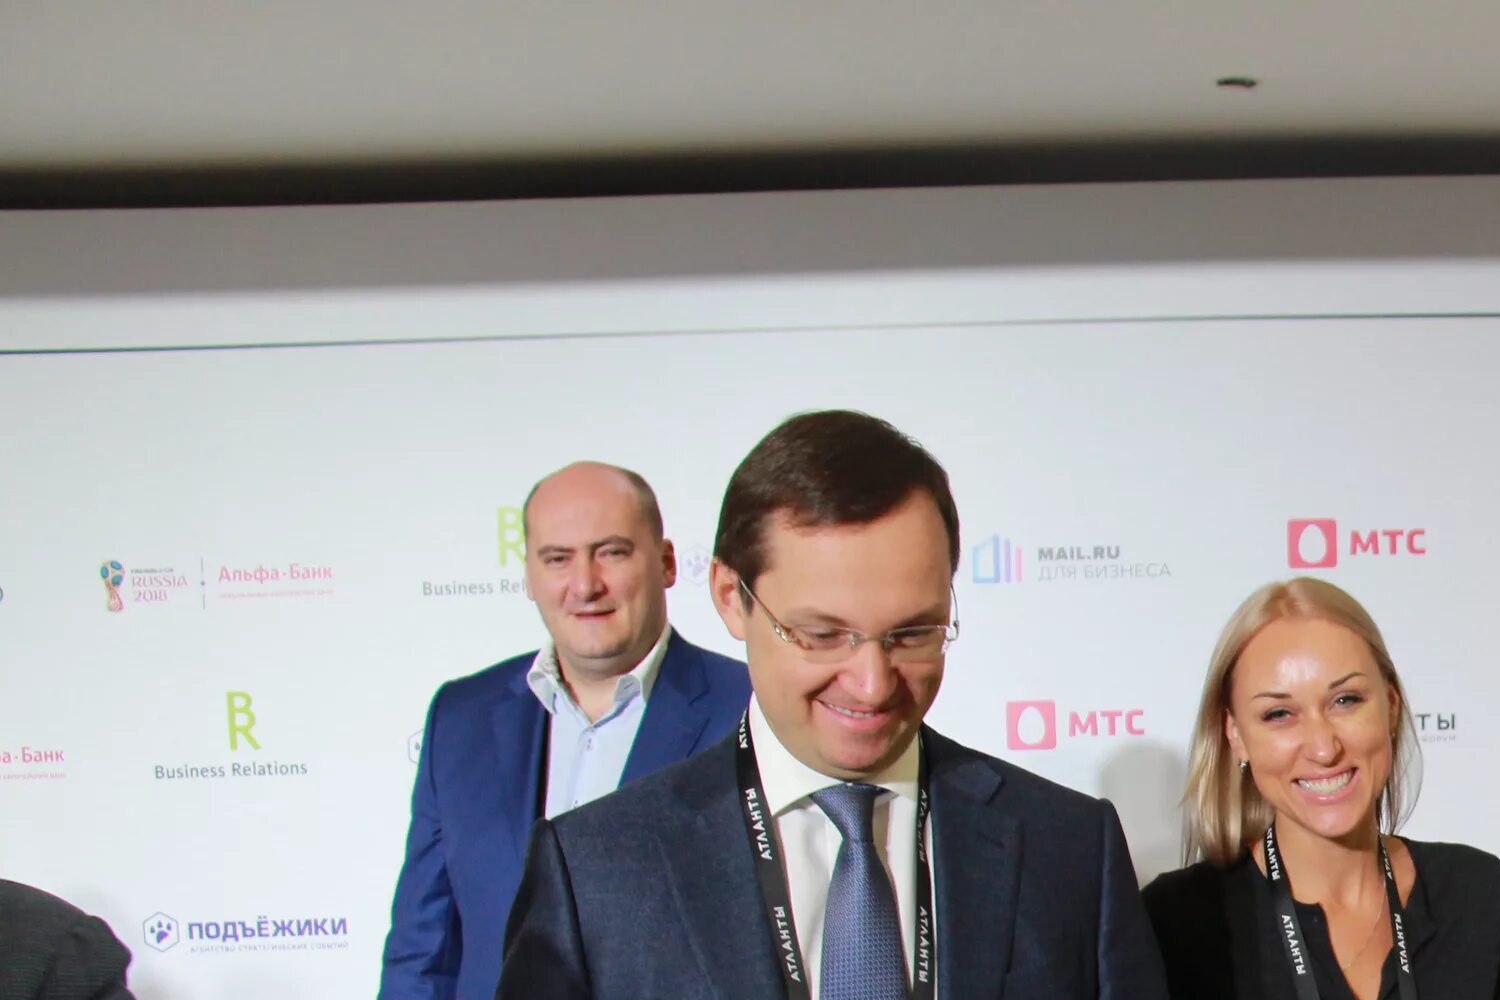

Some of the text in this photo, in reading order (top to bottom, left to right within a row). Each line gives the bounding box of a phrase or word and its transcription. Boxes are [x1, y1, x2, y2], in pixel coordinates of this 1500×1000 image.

[1037, 545, 1121, 561] MAIL.RU
[1350, 528, 1426, 555] МТС
[1038, 563, 1171, 582] ДЛЯ БИЗНЕСА
[133, 589, 168, 602] 2018
[422, 581, 493, 596] Business
[1068, 708, 1145, 736] МТС
[154, 761, 308, 780] Business Relations
[745, 788, 773, 861] АТЛАНТЫ
[187, 914, 349, 942] ПОДЪЁЖИКИ
[774, 905, 802, 982] АТЛАНТЫ
[918, 905, 930, 983] АТЛАНТЫ
[1281, 914, 1306, 975] АТЛАНТЫ
[1393, 913, 1410, 974] АТЛАНТЫ
